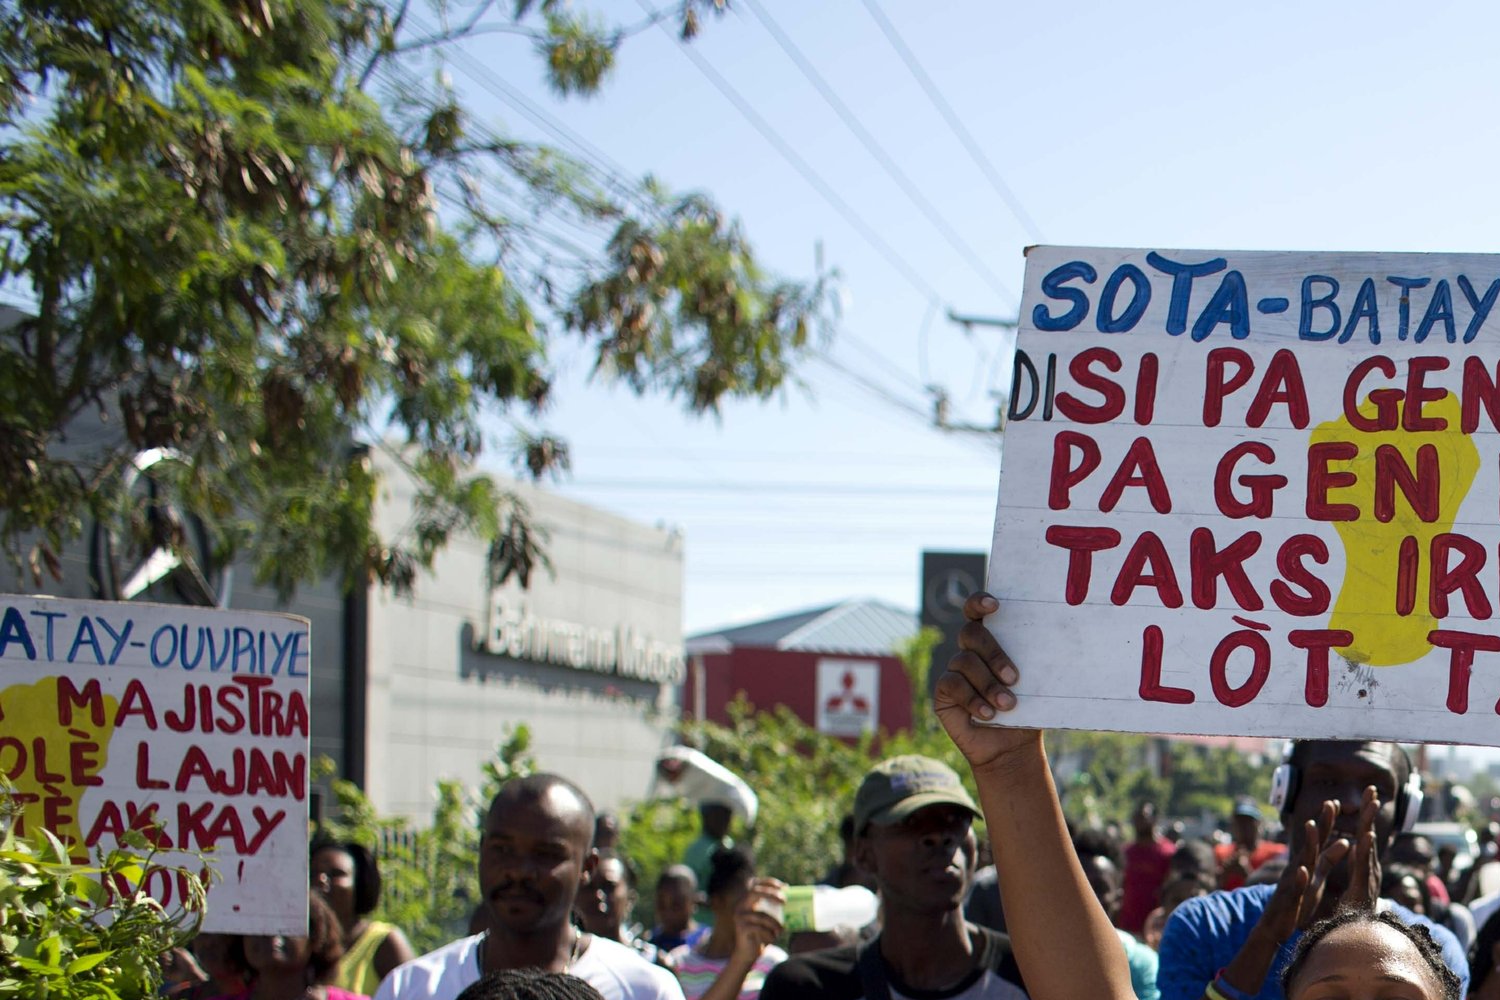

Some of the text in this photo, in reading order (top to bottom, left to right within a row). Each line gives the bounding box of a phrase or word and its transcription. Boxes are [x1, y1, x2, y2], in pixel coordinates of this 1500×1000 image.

[1202, 347, 1310, 430] PA
[1048, 430, 1172, 516] PA
[1213, 441, 1440, 523] GEN
[1045, 525, 1331, 617] TAKS
[1138, 615, 1353, 708] LÒT
[57, 675, 309, 738] MAJISTRA
[136, 742, 306, 802] LAJAN
